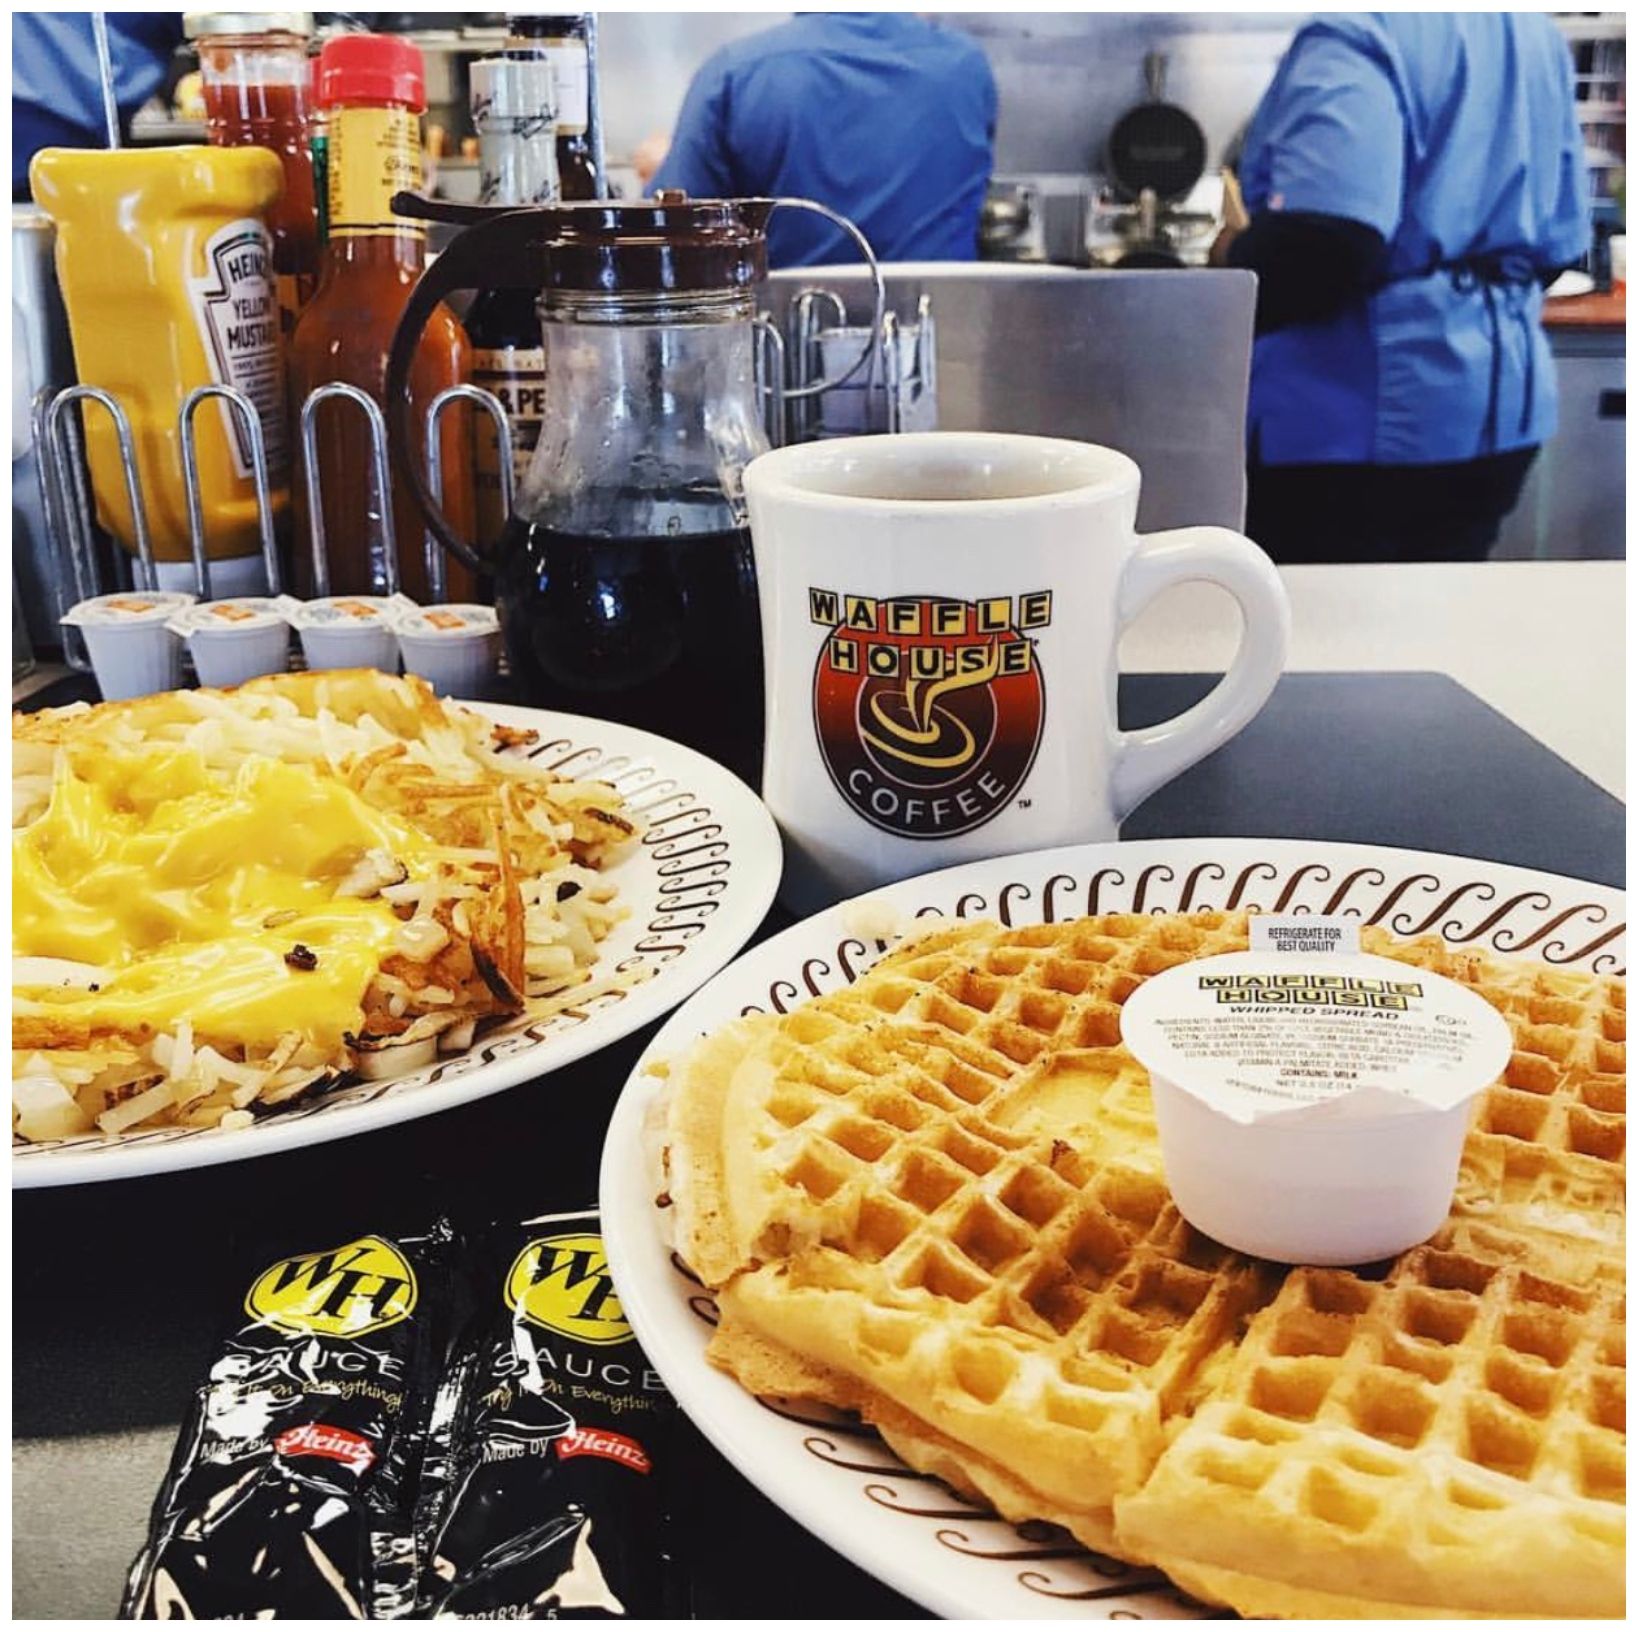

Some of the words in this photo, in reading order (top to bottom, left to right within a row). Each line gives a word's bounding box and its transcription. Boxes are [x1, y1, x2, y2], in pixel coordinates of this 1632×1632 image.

[809, 587, 1052, 634] WAFFLE
[830, 638, 1031, 680] HOUSE
[849, 768, 1006, 824] COFFEE
[1268, 928, 1323, 939] REFRIGERATE
[1324, 928, 1342, 939] FOR
[1277, 940, 1297, 951] BEST
[1298, 941, 1336, 952] QUALITY
[1200, 976, 1423, 997] WAFFLE
[1218, 990, 1408, 1010] HOUSE
[1230, 1006, 1316, 1015] WHIPPED
[1319, 1008, 1399, 1020] SPREAD
[272, 1247, 411, 1320] WH
[490, 1346, 668, 1392] SAUCE
[482, 1441, 526, 1464] Made
[529, 1437, 549, 1458] by
[562, 1430, 649, 1467] Heinz
